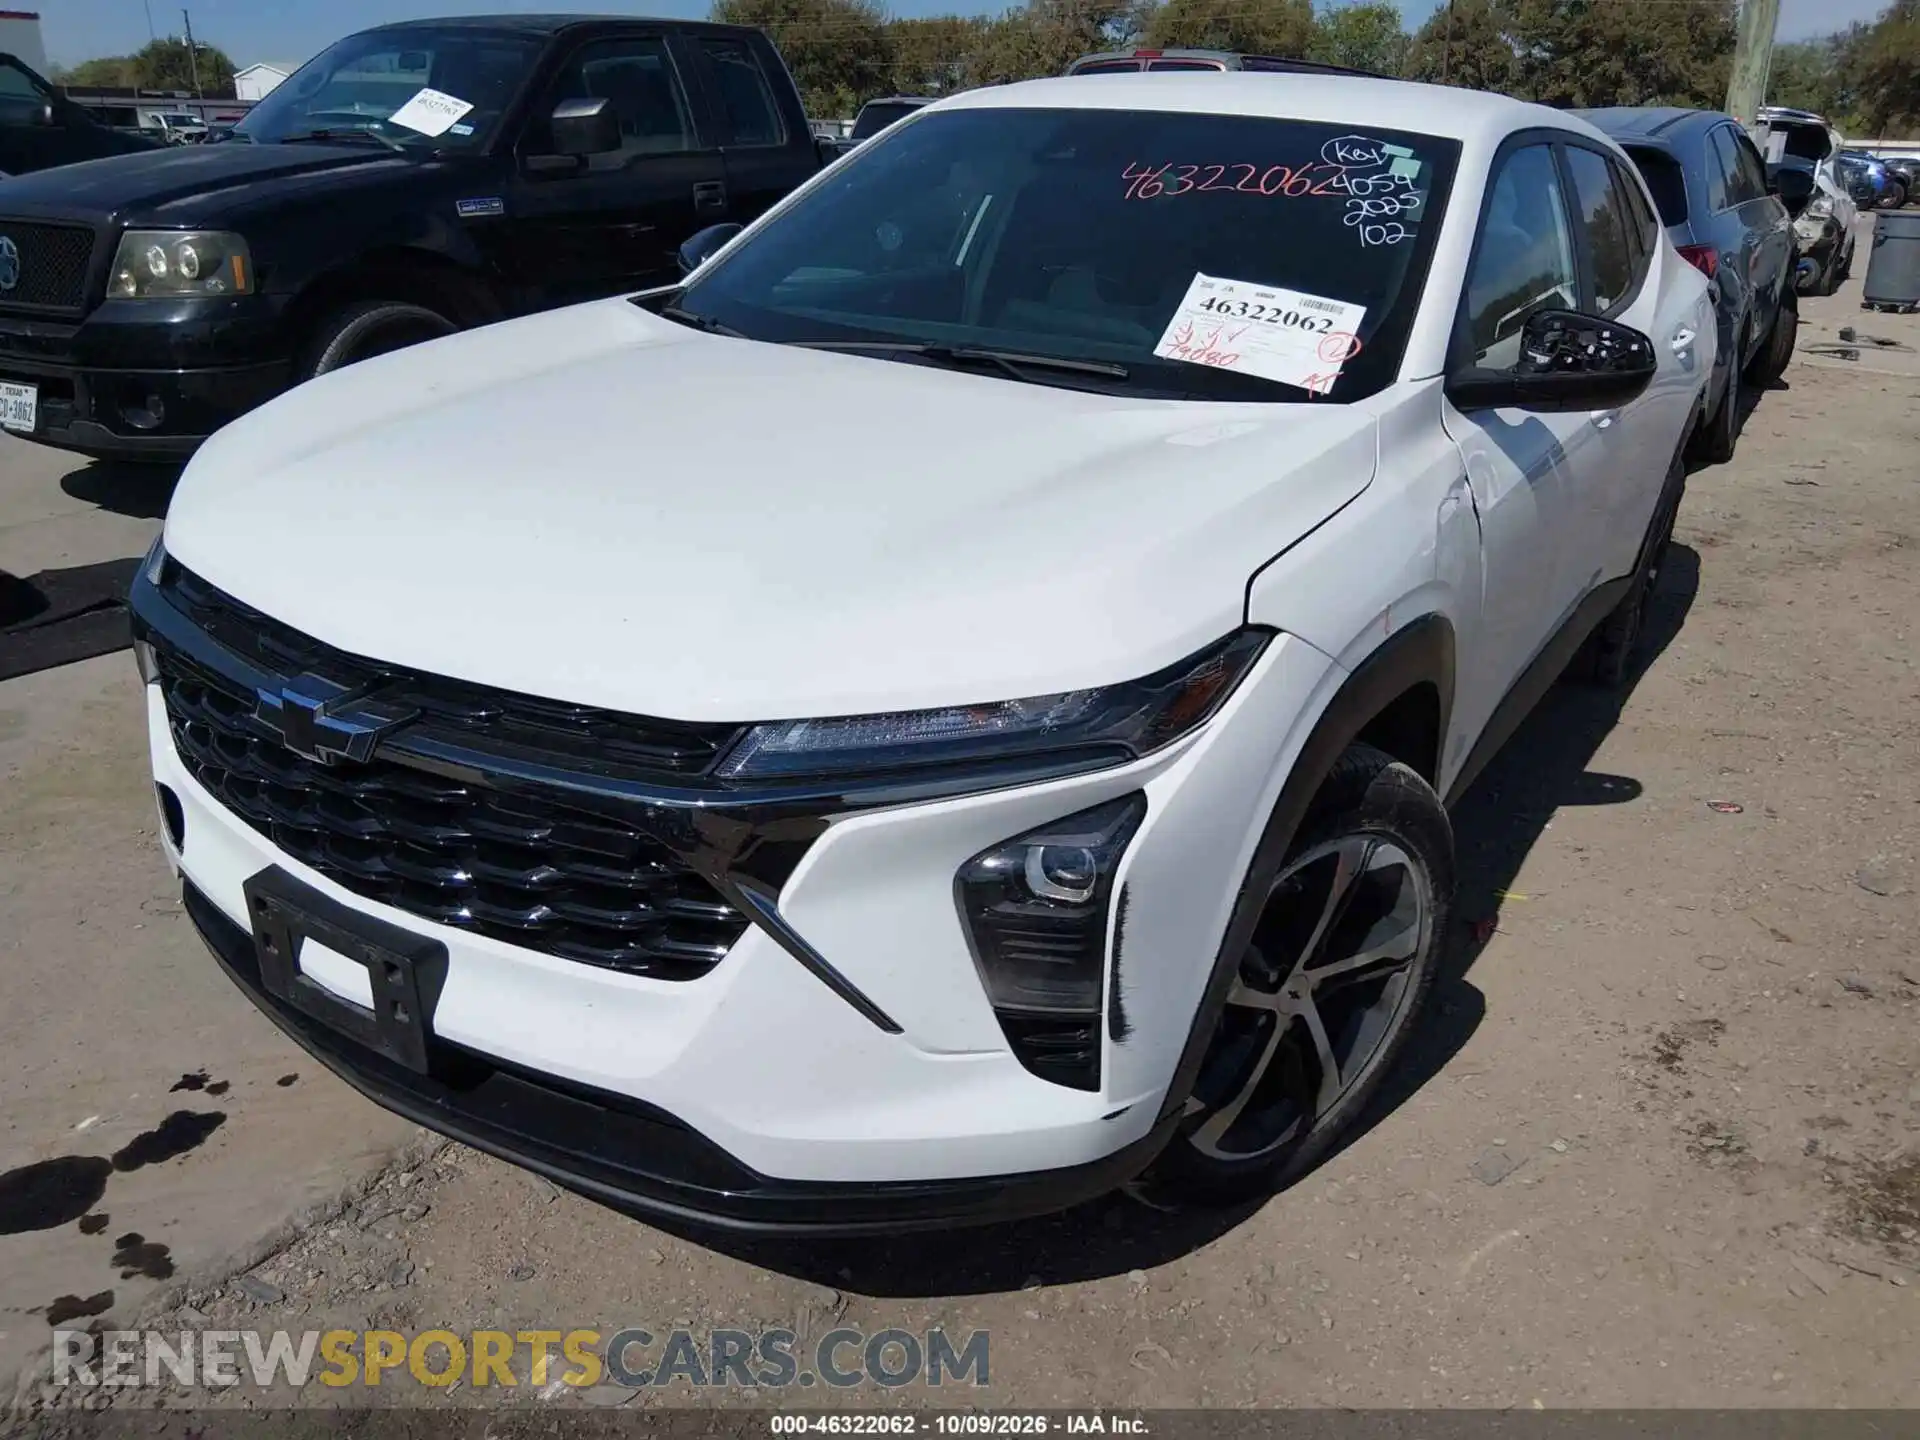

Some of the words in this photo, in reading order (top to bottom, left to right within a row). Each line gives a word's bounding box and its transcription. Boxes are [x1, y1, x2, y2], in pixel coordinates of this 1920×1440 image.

[1122, 162, 1348, 200] 46322062
[1343, 190, 1422, 226] 2025
[1359, 222, 1417, 248] 102
[1199, 296, 1334, 335] 46322062
[5, 387, 23, 397] TEXAS
